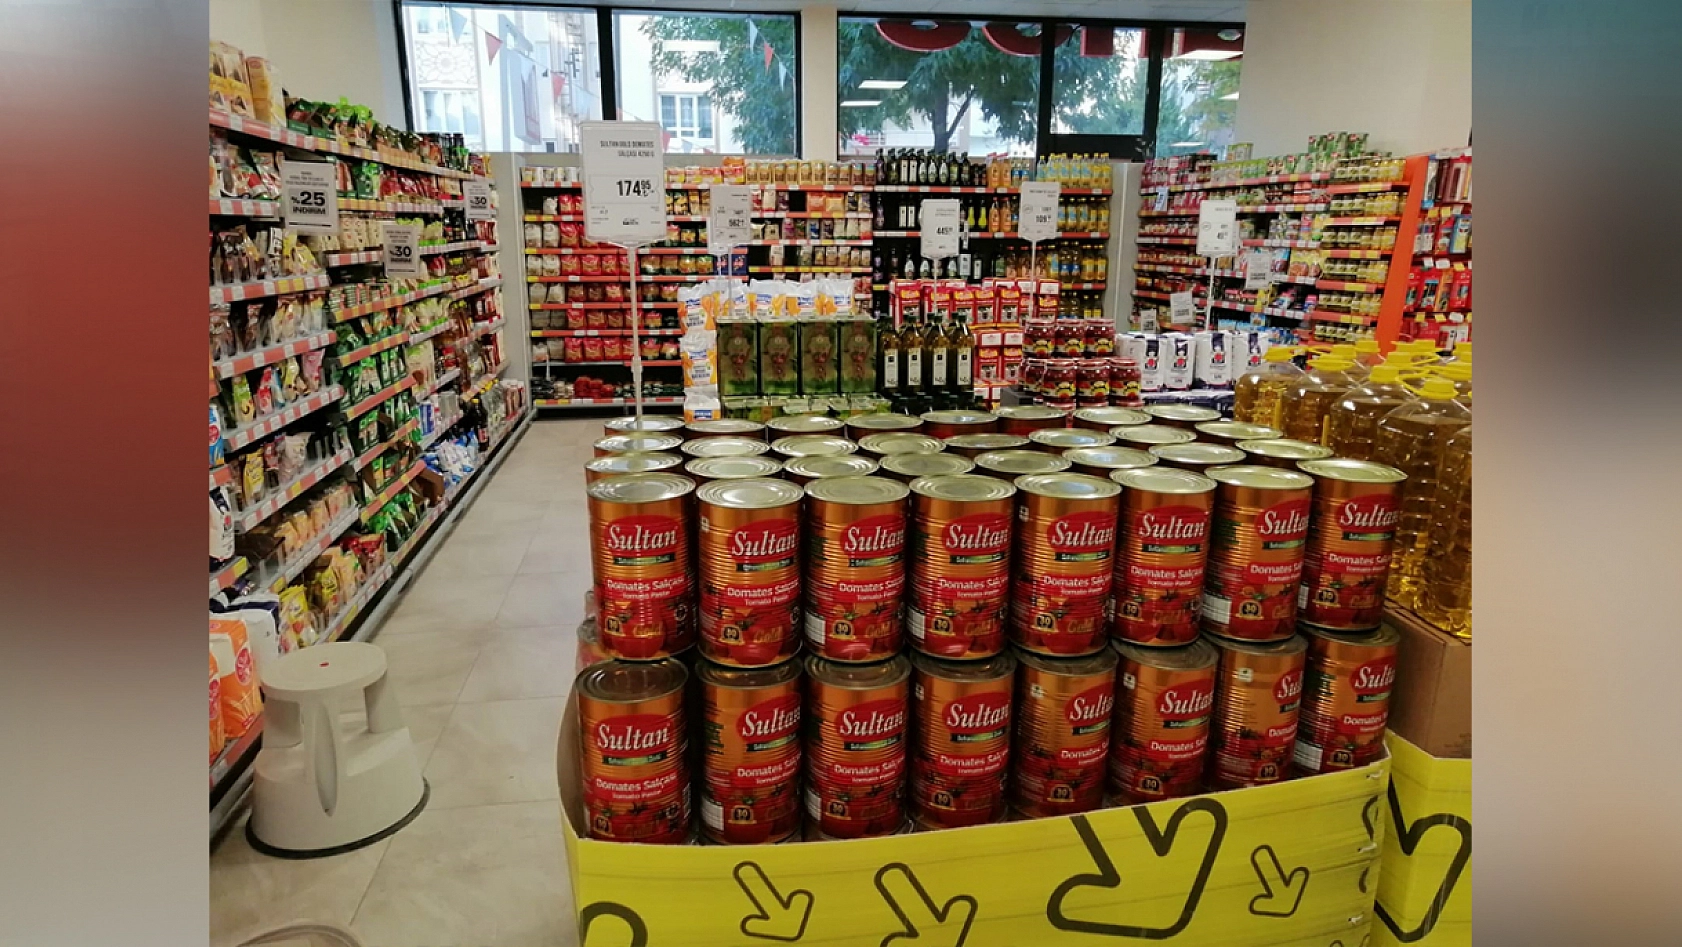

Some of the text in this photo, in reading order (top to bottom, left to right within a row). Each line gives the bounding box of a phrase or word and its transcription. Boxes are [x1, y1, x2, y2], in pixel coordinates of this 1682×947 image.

[1138, 512, 1204, 538] Sultan
[608, 524, 677, 550] Sultan
[844, 526, 904, 552] Sultan
[946, 523, 1008, 548] Sultan
[1052, 521, 1114, 546] Sultan
[732, 530, 795, 556] Sultan
[1330, 553, 1374, 564] Domates
[1130, 566, 1176, 578] Domates
[1250, 564, 1292, 574] Domates
[608, 580, 650, 592] Domates
[940, 579, 985, 590] Domates
[1044, 576, 1088, 586] Domates
[728, 588, 773, 598] Domates
[840, 583, 884, 592] Domates
[946, 704, 1009, 728] Sultan
[840, 710, 903, 736] Sultan
[598, 724, 669, 750] Sultan
[1152, 740, 1194, 752] Domates
[940, 754, 986, 766] Domates
[738, 764, 782, 777] Domates
[834, 764, 880, 776] Domates
[596, 778, 642, 792] Domates
